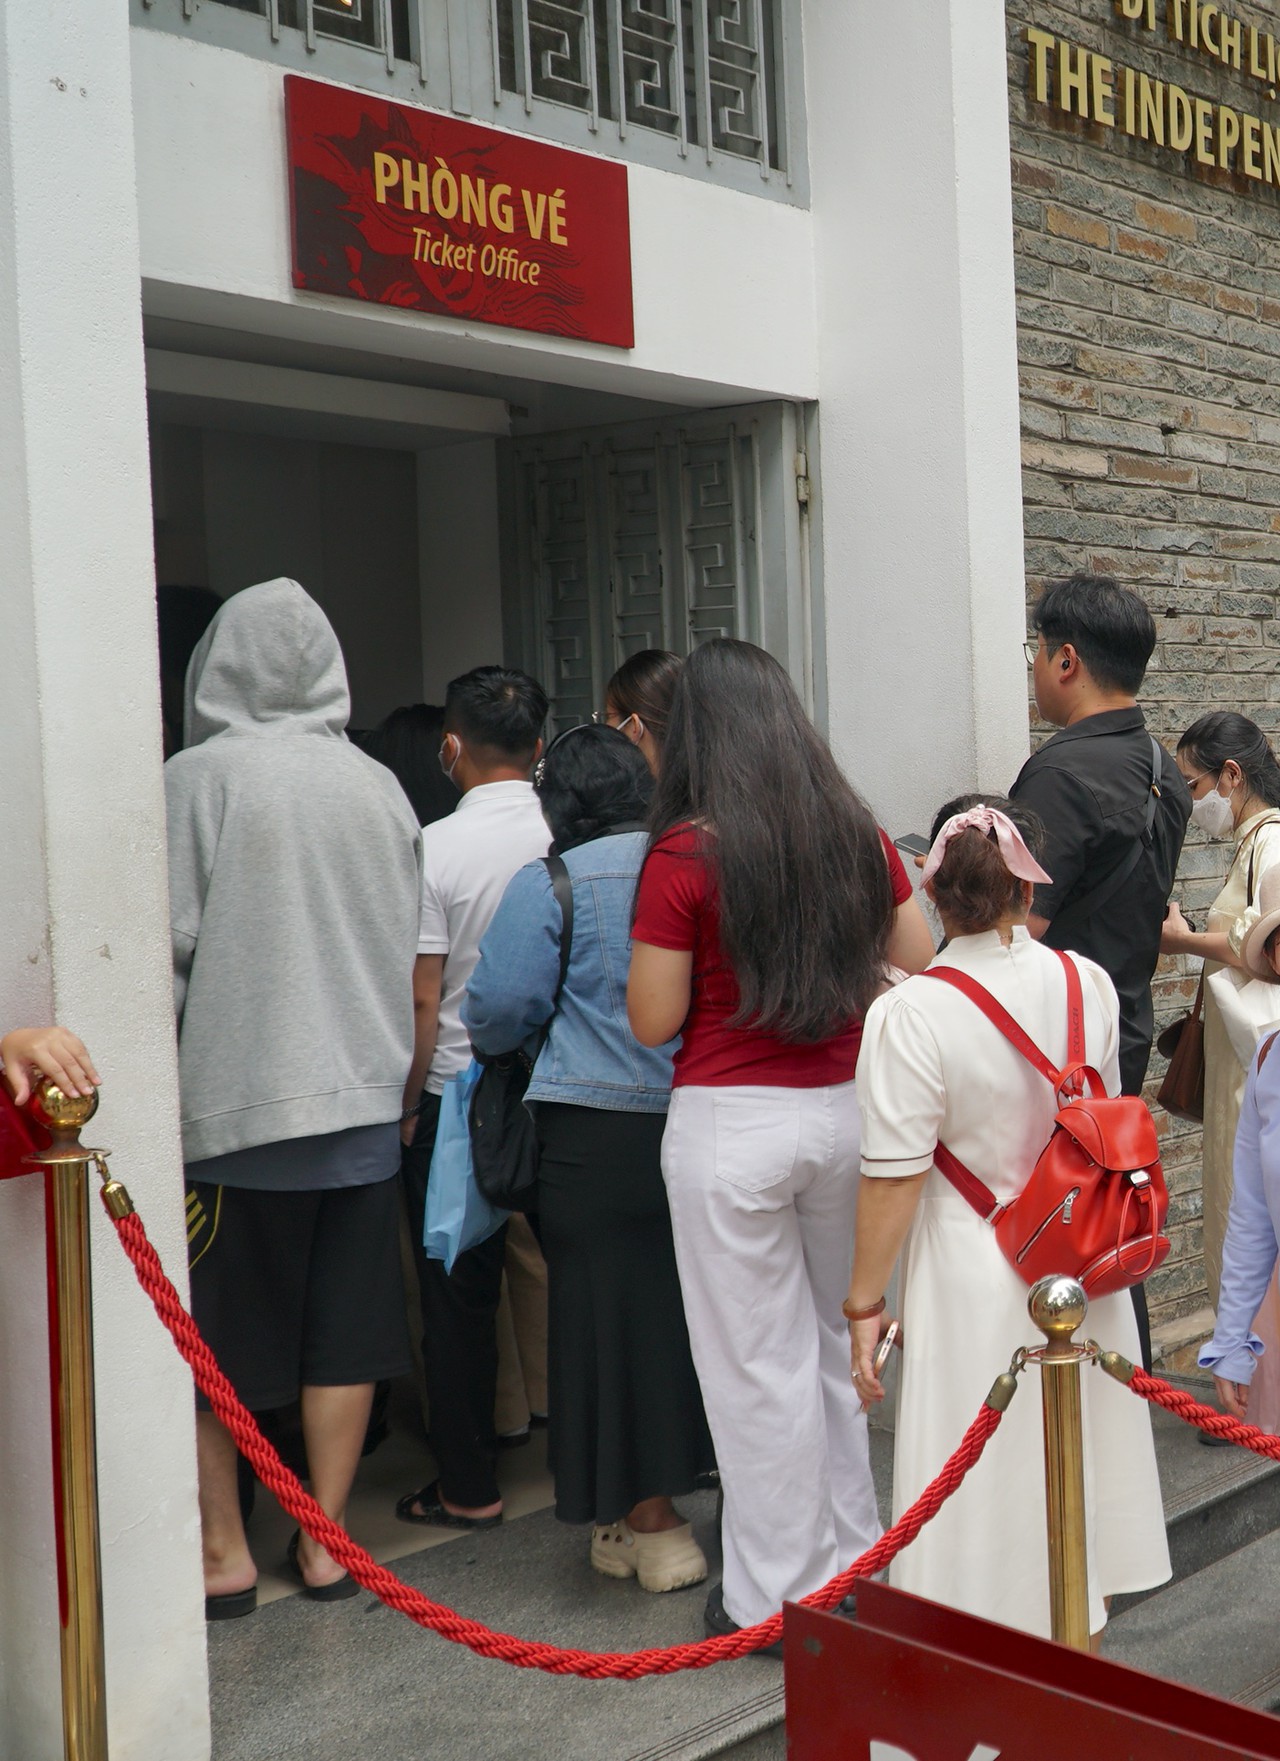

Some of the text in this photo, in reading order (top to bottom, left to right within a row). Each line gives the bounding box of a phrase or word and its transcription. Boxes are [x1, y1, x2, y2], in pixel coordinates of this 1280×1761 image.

[1027, 27, 1115, 127] THE
[373, 151, 568, 247] PHÒNG VÉ
[412, 227, 541, 286] Ticket Office
